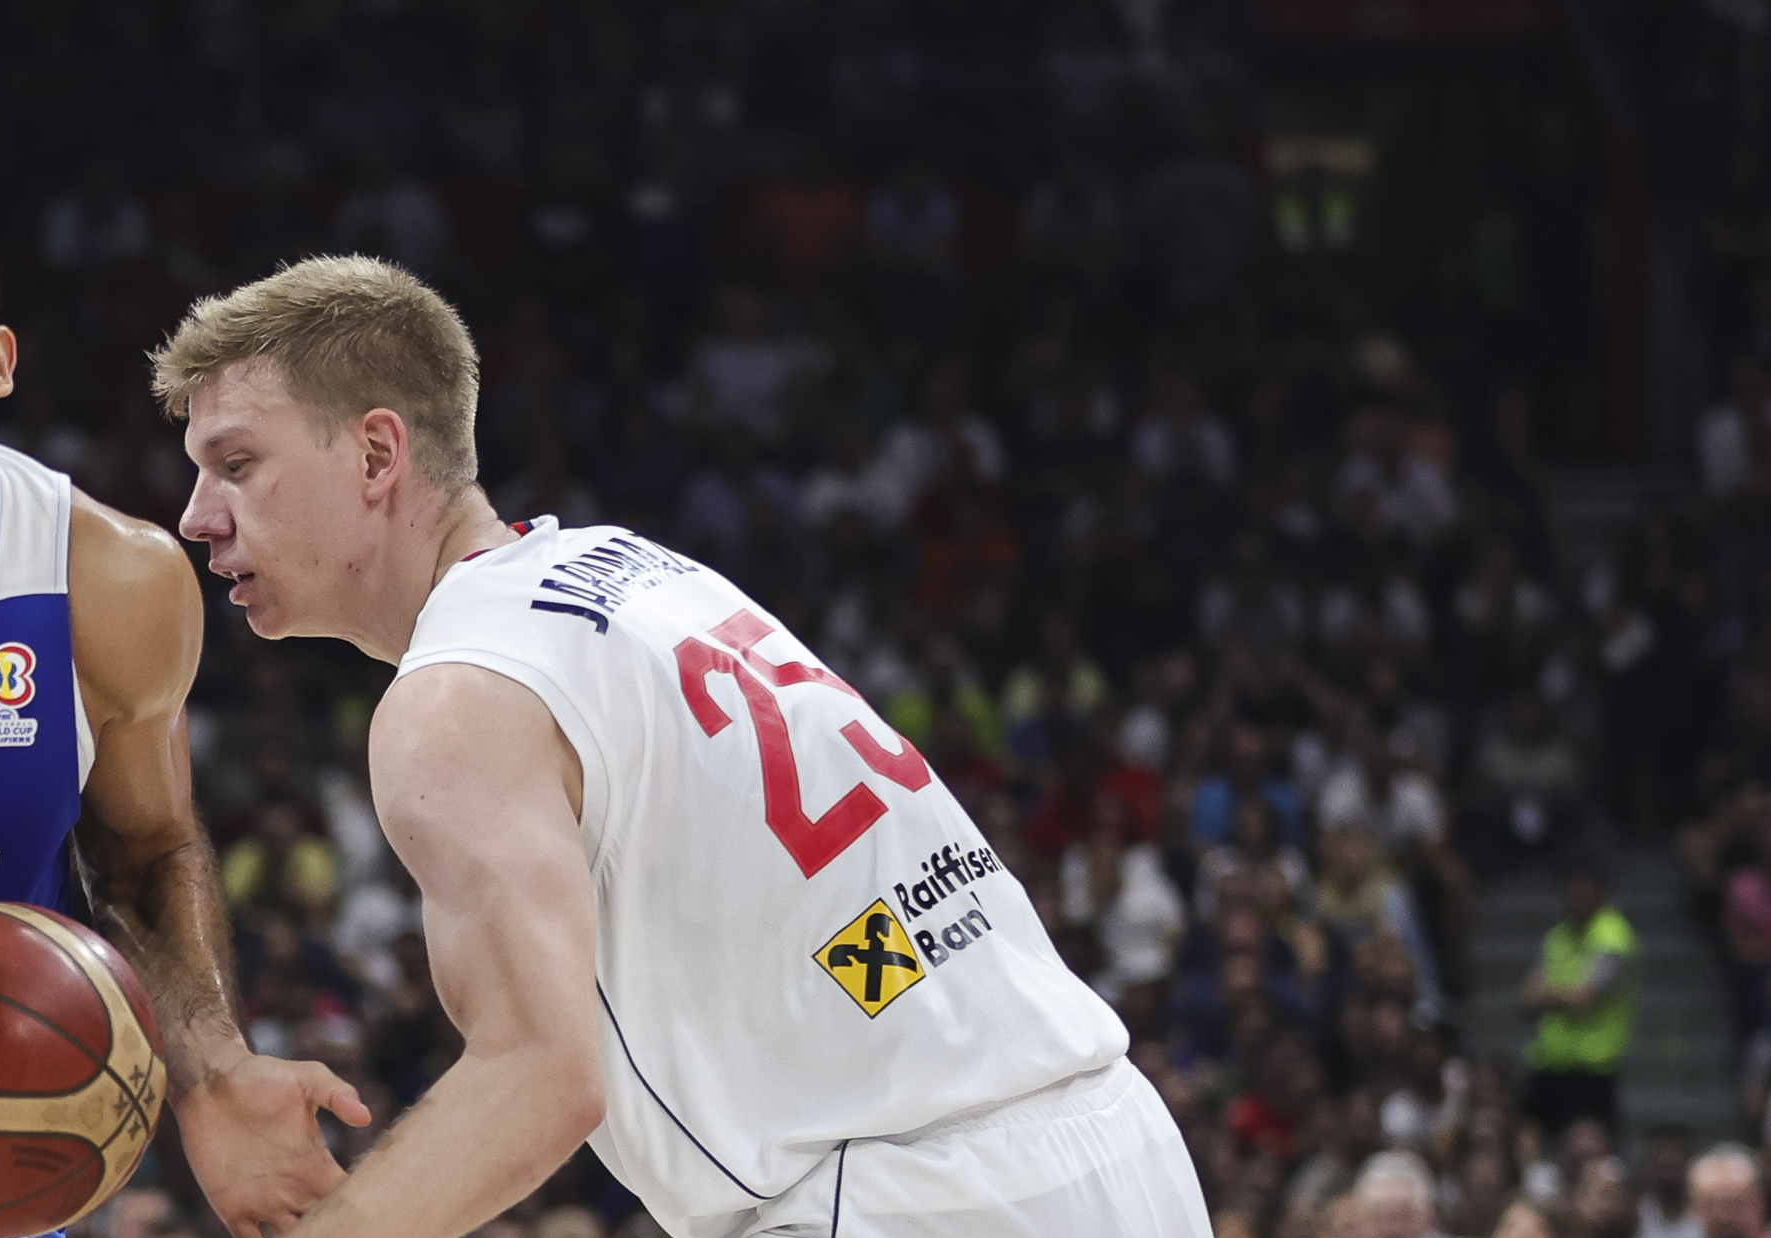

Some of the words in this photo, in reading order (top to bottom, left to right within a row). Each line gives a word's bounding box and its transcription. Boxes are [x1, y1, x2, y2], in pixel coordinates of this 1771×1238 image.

[12, 726, 34, 735] CUP
[672, 607, 932, 880] 25
[893, 842, 1004, 923] Raiffisen
[914, 891, 993, 969] Ban
